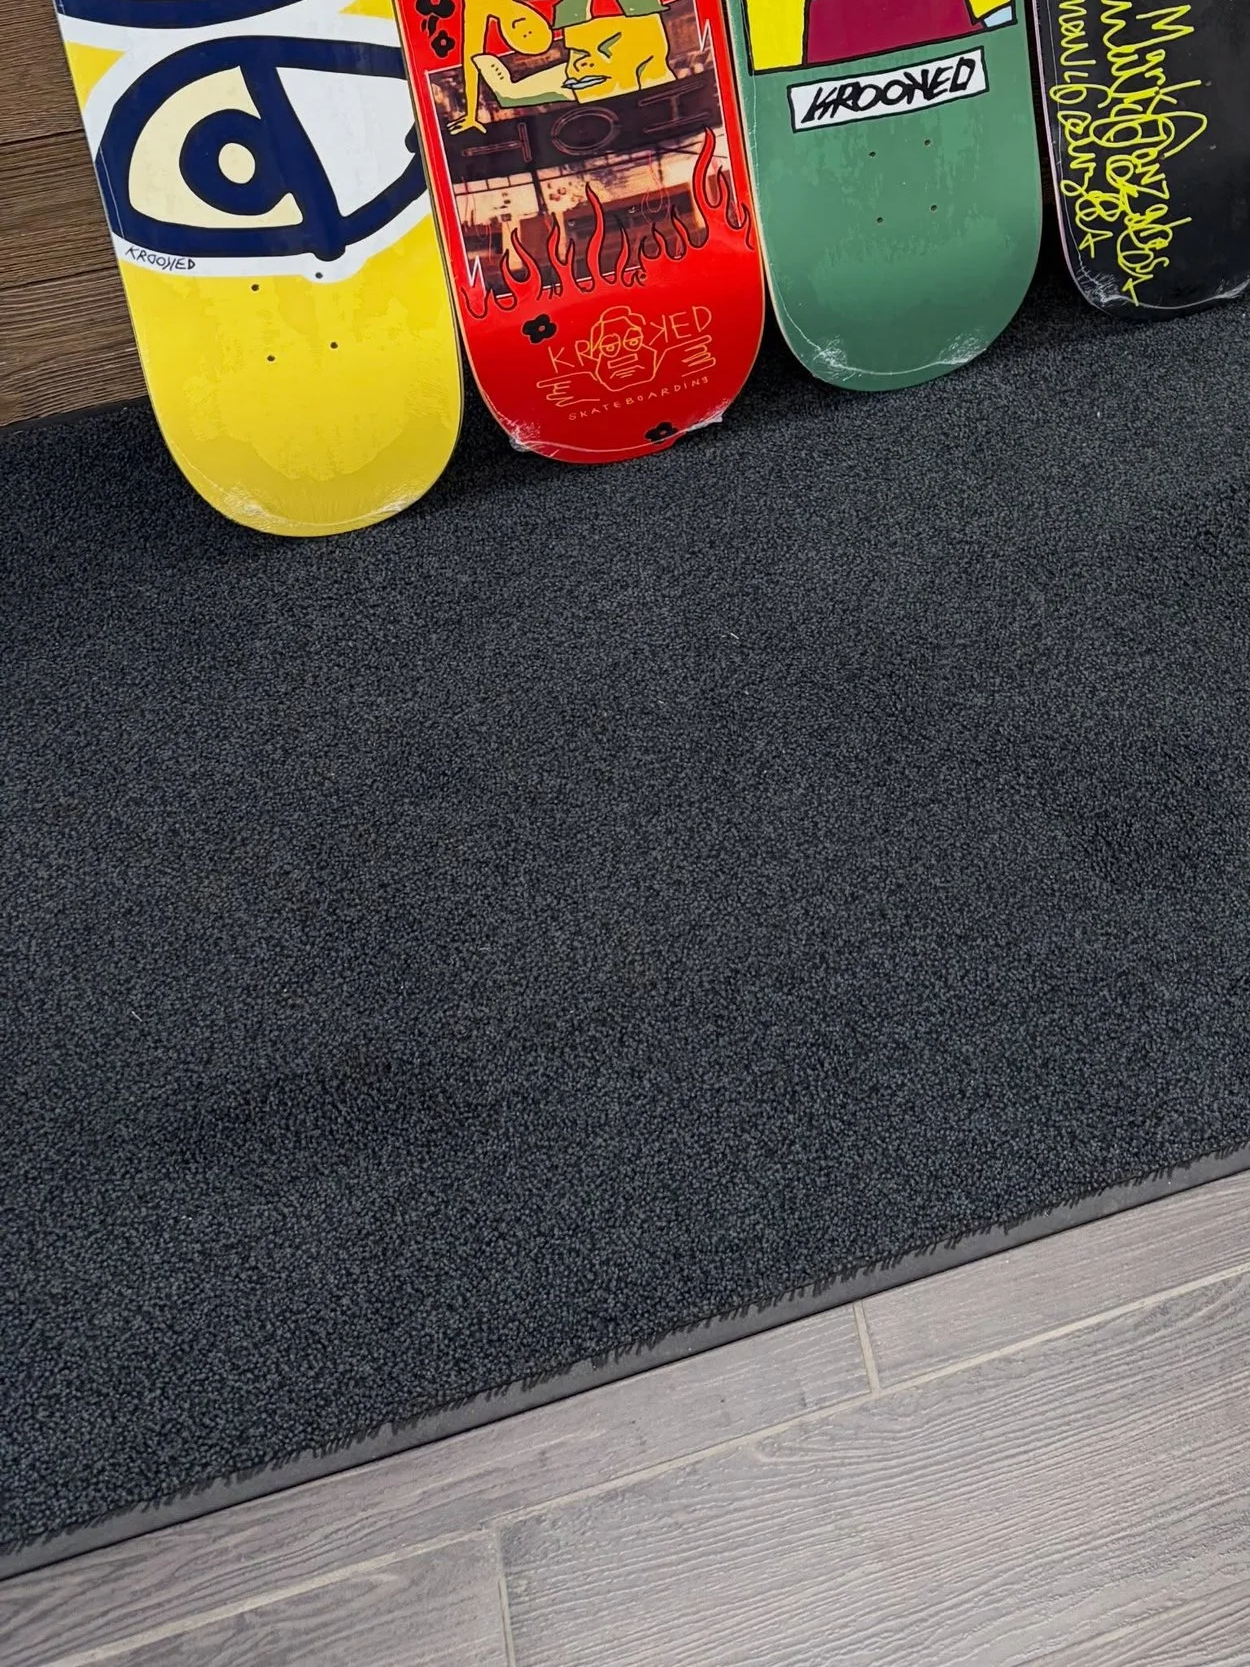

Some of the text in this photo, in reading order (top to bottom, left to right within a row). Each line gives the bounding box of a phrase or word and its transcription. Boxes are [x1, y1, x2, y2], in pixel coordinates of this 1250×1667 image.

[801, 56, 976, 125] KROOKED
[125, 245, 196, 272] KROOKED
[567, 375, 710, 421] SKATEBOARDING
